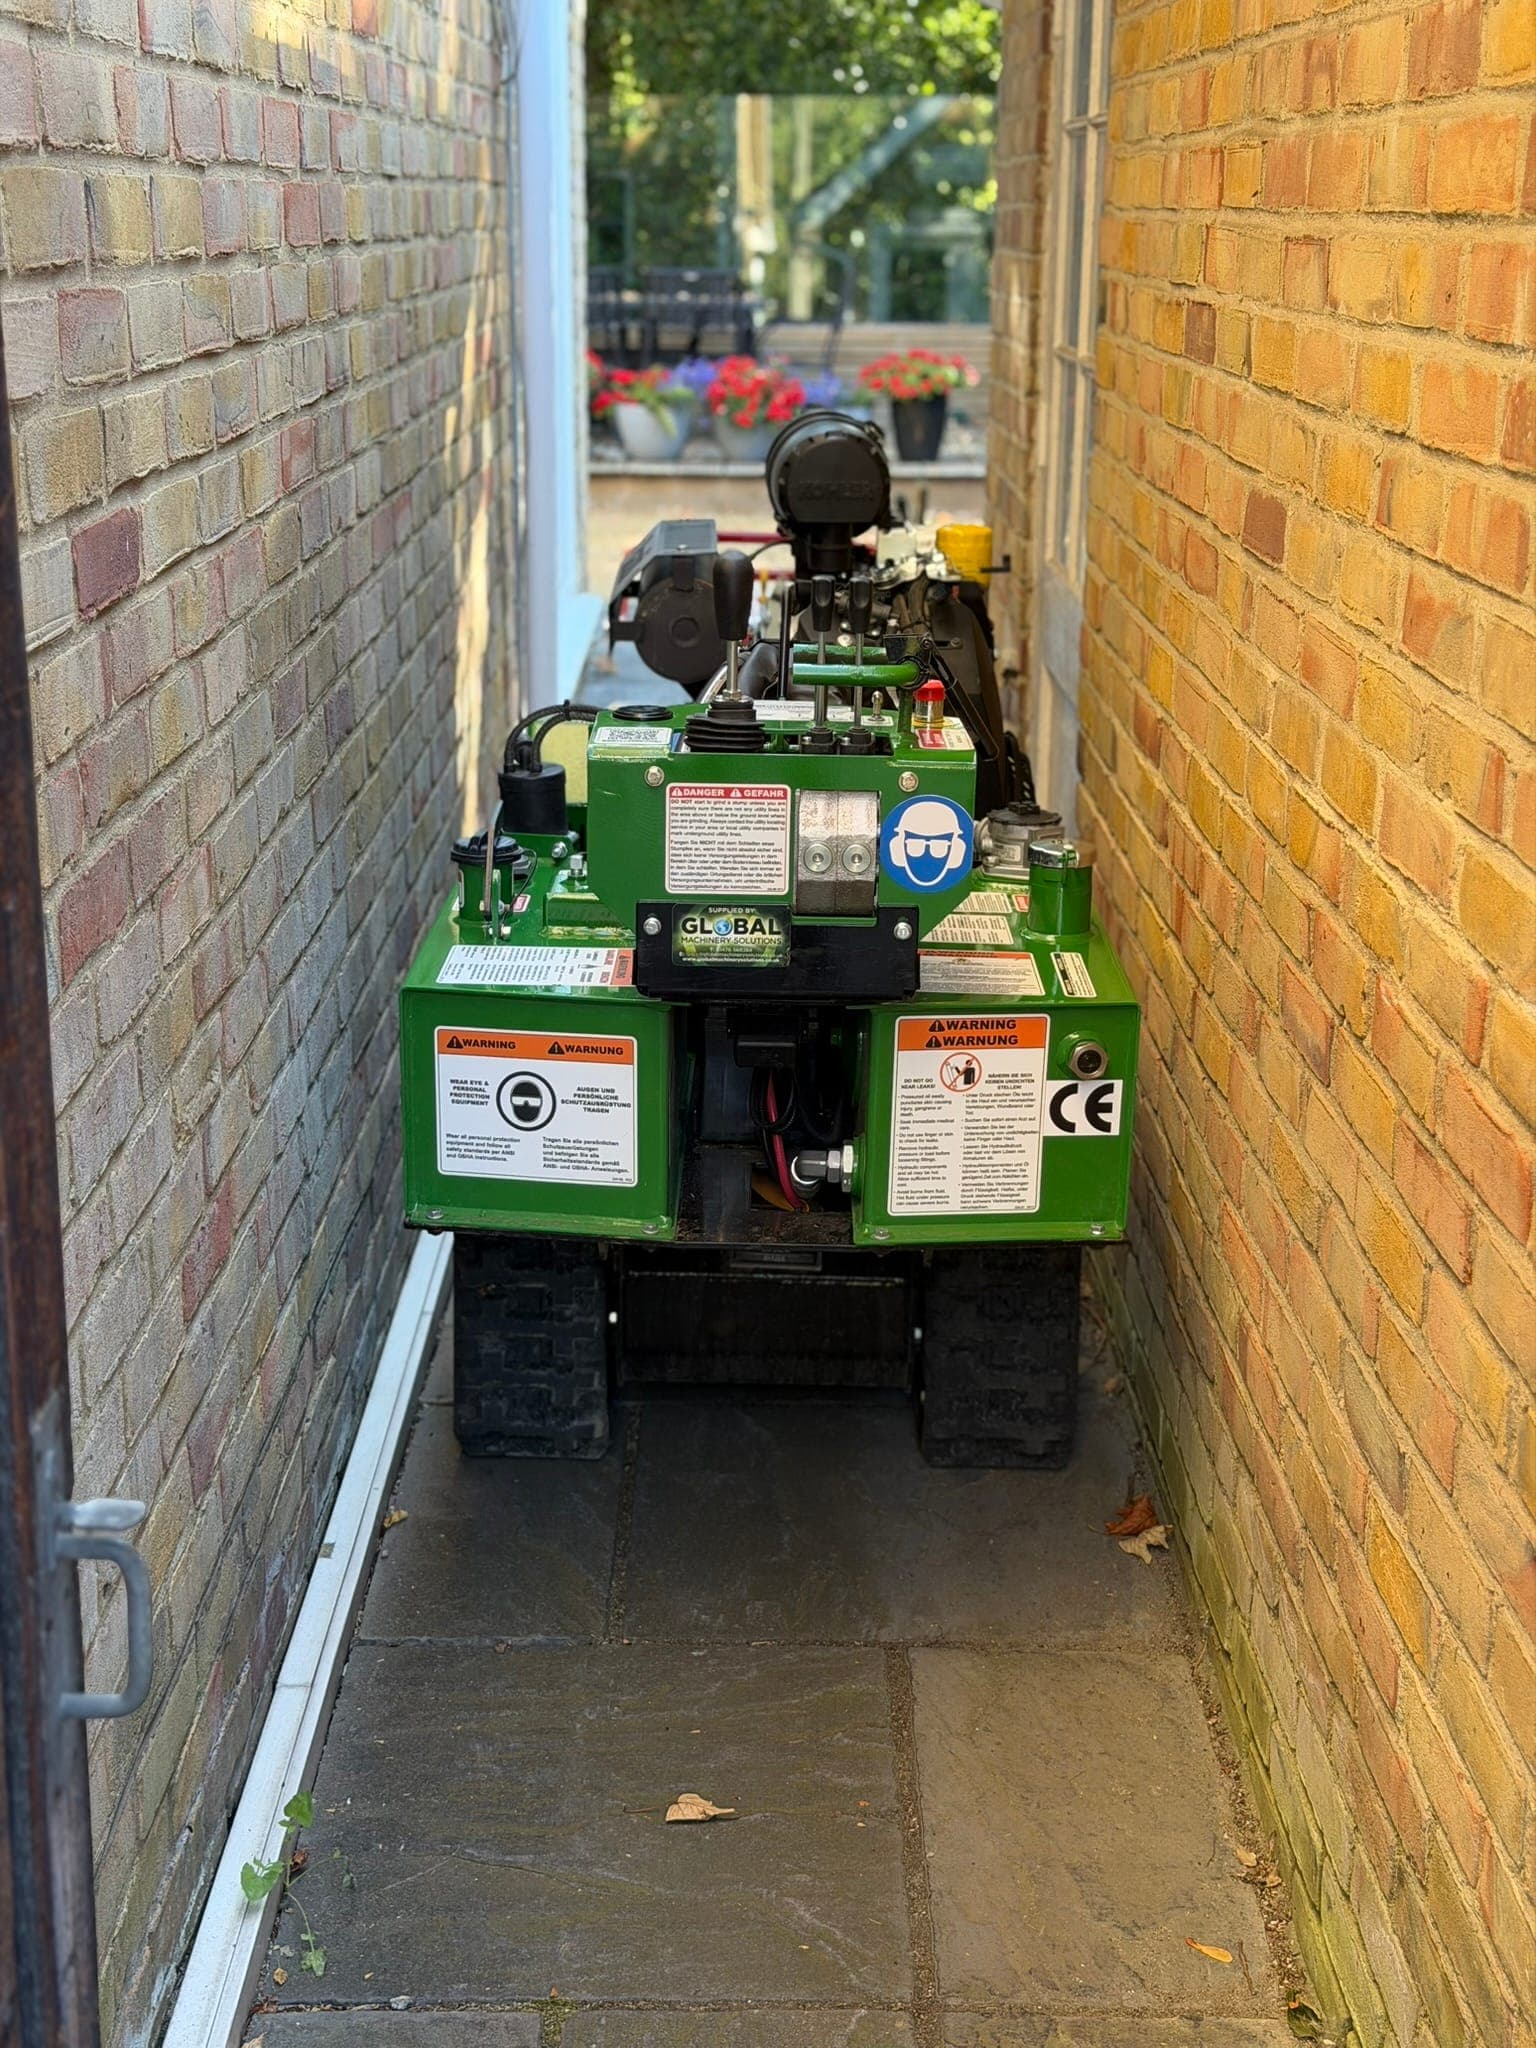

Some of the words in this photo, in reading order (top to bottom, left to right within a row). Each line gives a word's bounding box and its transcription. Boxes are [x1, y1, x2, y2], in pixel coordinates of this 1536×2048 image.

[681, 918, 781, 936] GLOBAL
[946, 1020, 1016, 1031] WARNING
[463, 1039, 516, 1049] WARNING
[943, 1036, 1018, 1046] WARNUNG
[565, 1044, 624, 1055] WARNUNG
[561, 1099, 631, 1107] SCHUTZAUSRÜSTUNG
[1049, 1083, 1114, 1133] CE
